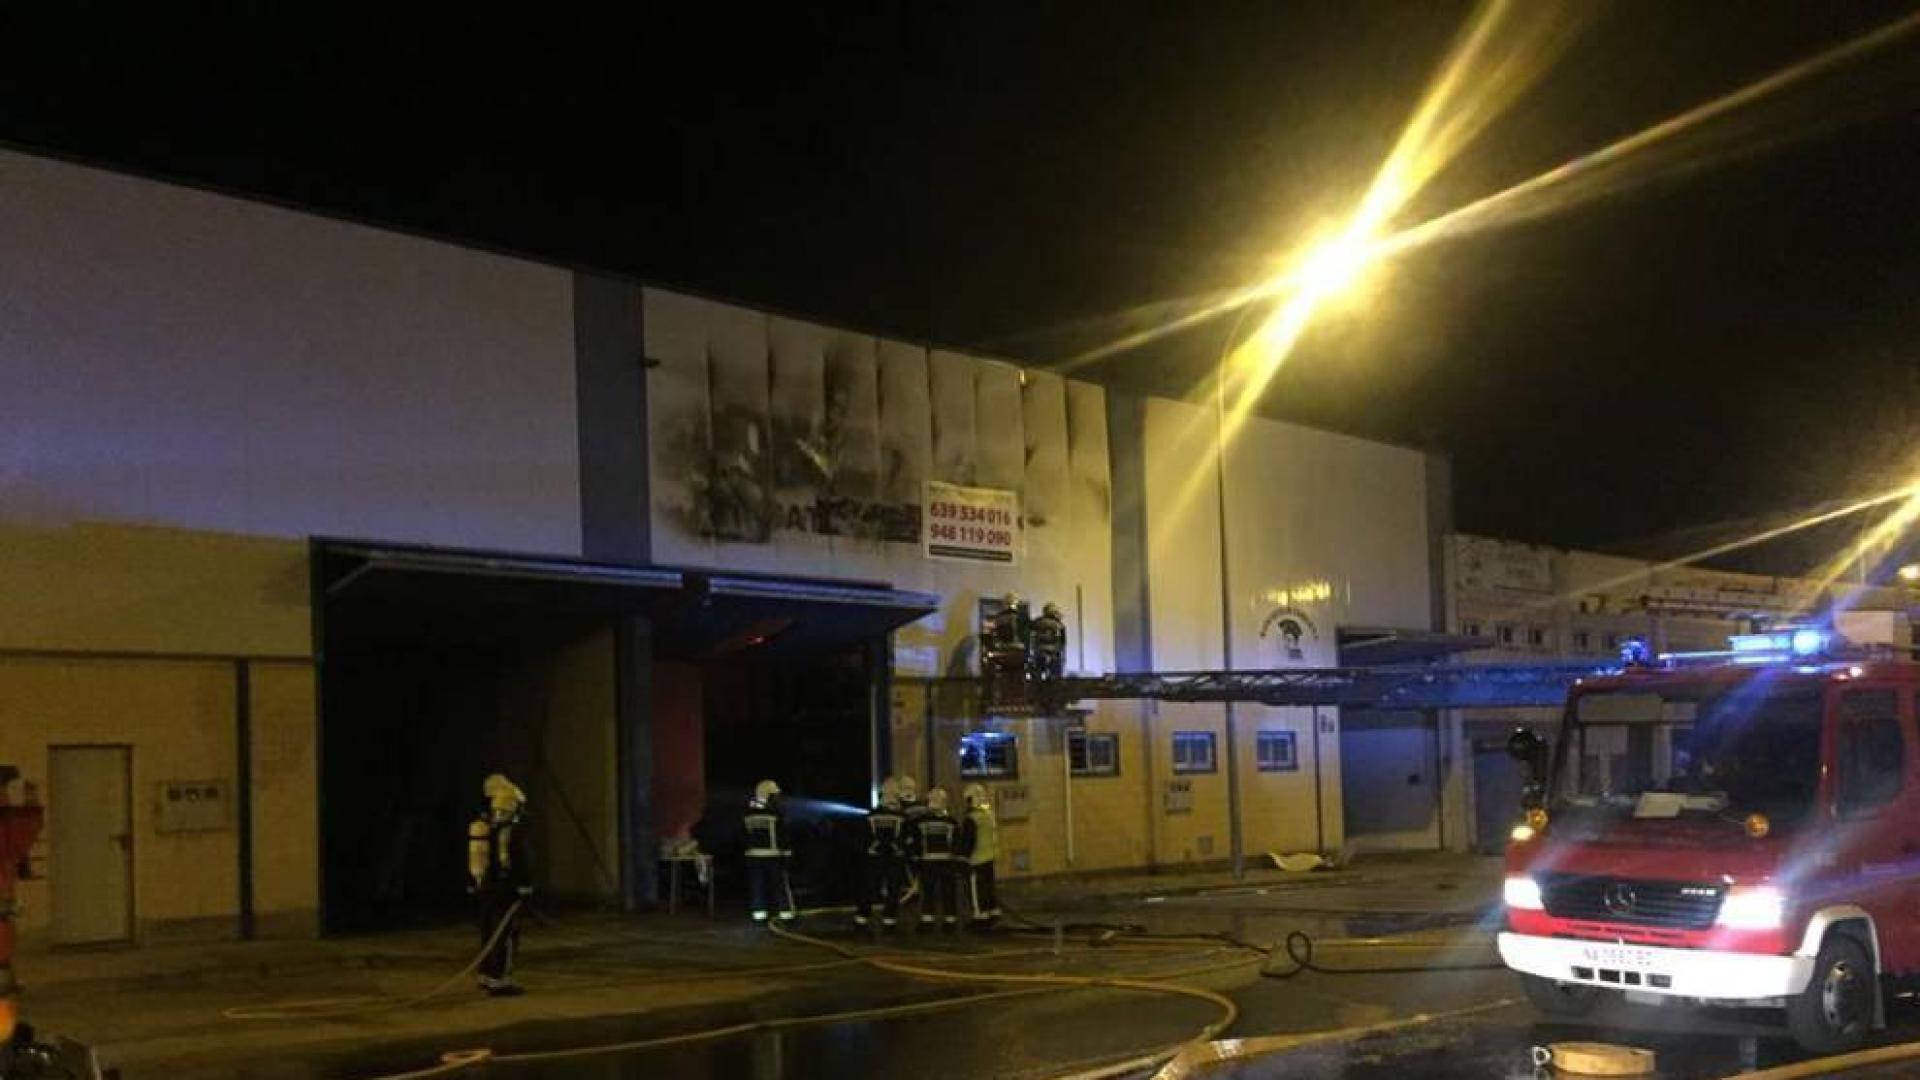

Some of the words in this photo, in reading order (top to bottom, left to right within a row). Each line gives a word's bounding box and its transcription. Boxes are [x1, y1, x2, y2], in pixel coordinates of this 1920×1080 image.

[930, 502, 957, 519] 639
[960, 504, 985, 522] 534
[987, 507, 1011, 526] 016
[930, 523, 957, 540] 948
[961, 525, 985, 543] 119
[987, 529, 1011, 546] 090
